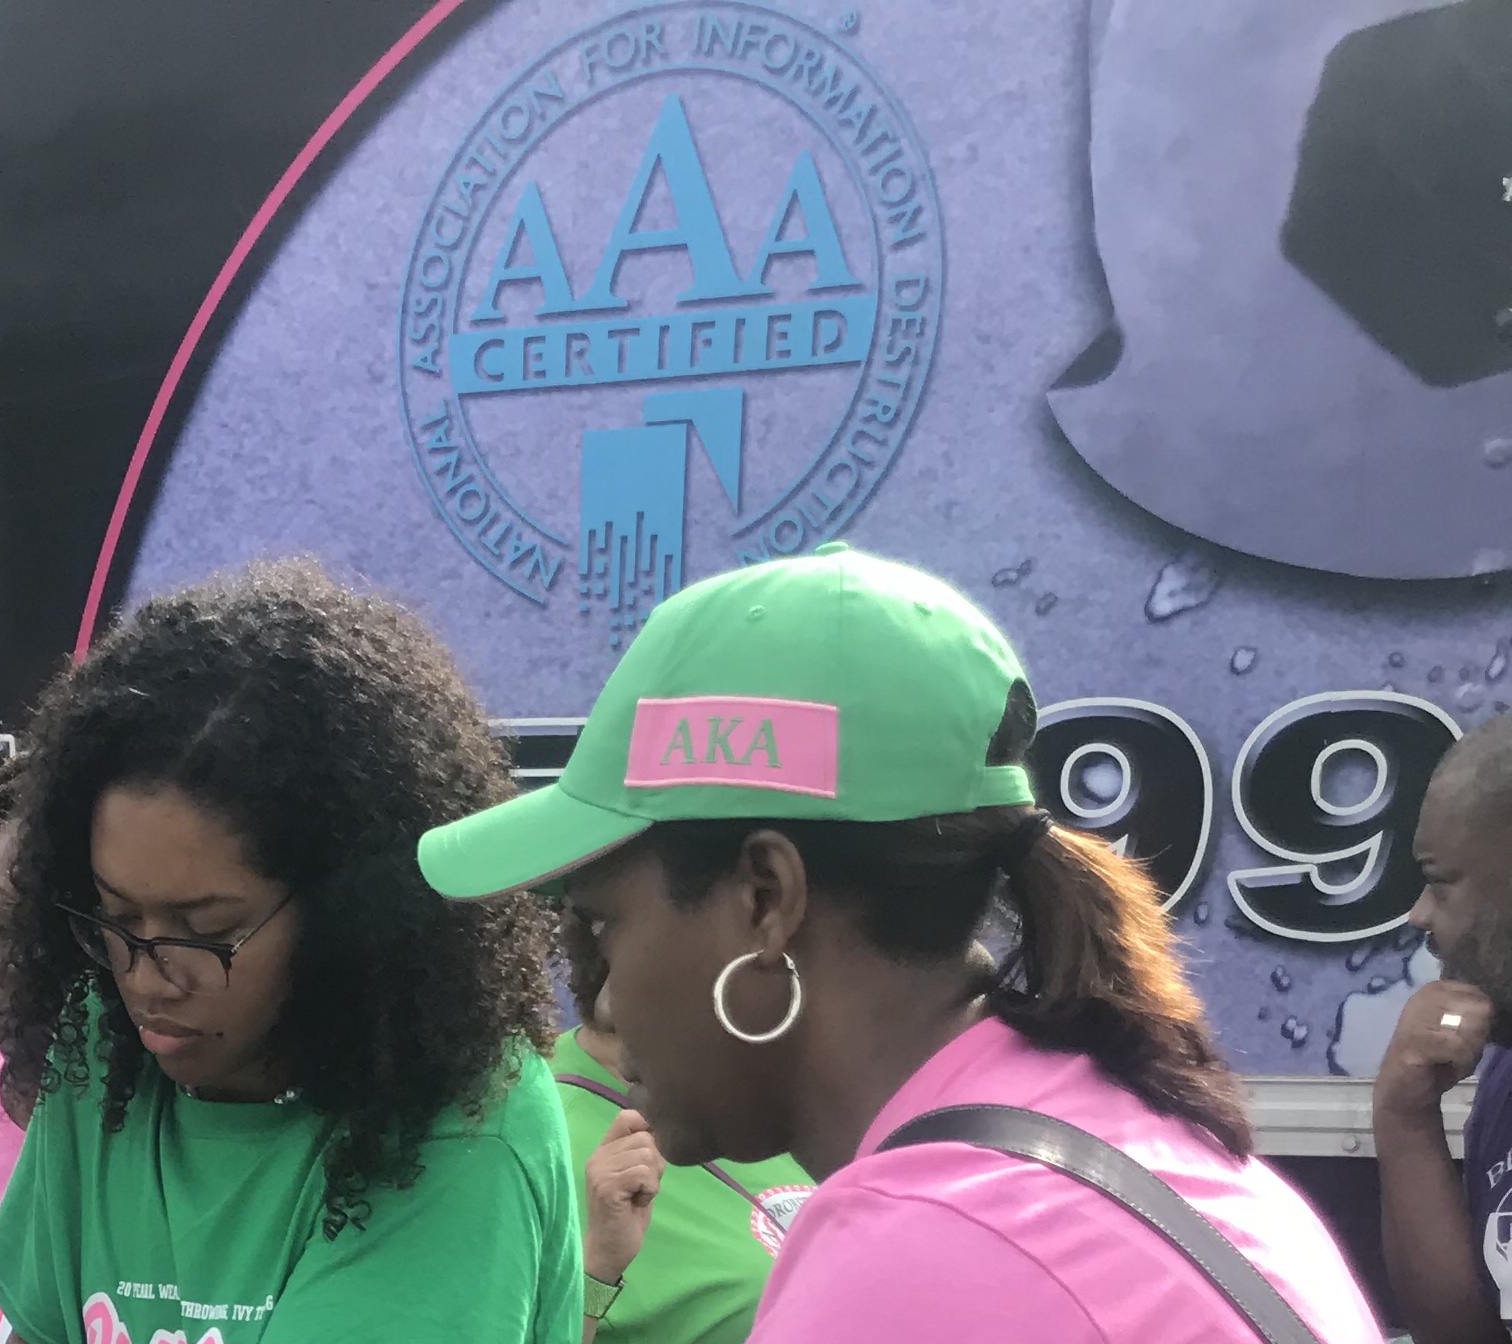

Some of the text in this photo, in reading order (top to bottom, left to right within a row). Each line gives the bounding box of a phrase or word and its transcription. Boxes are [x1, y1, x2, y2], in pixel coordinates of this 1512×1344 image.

[579, 14, 667, 81] FOR
[689, 13, 927, 251] INFORMATION
[408, 66, 566, 377] ASSOCIATION
[468, 92, 867, 323] AAA
[471, 307, 851, 384] CERTIFIED
[420, 399, 565, 590] NATIONAL
[658, 715, 784, 770] AKA
